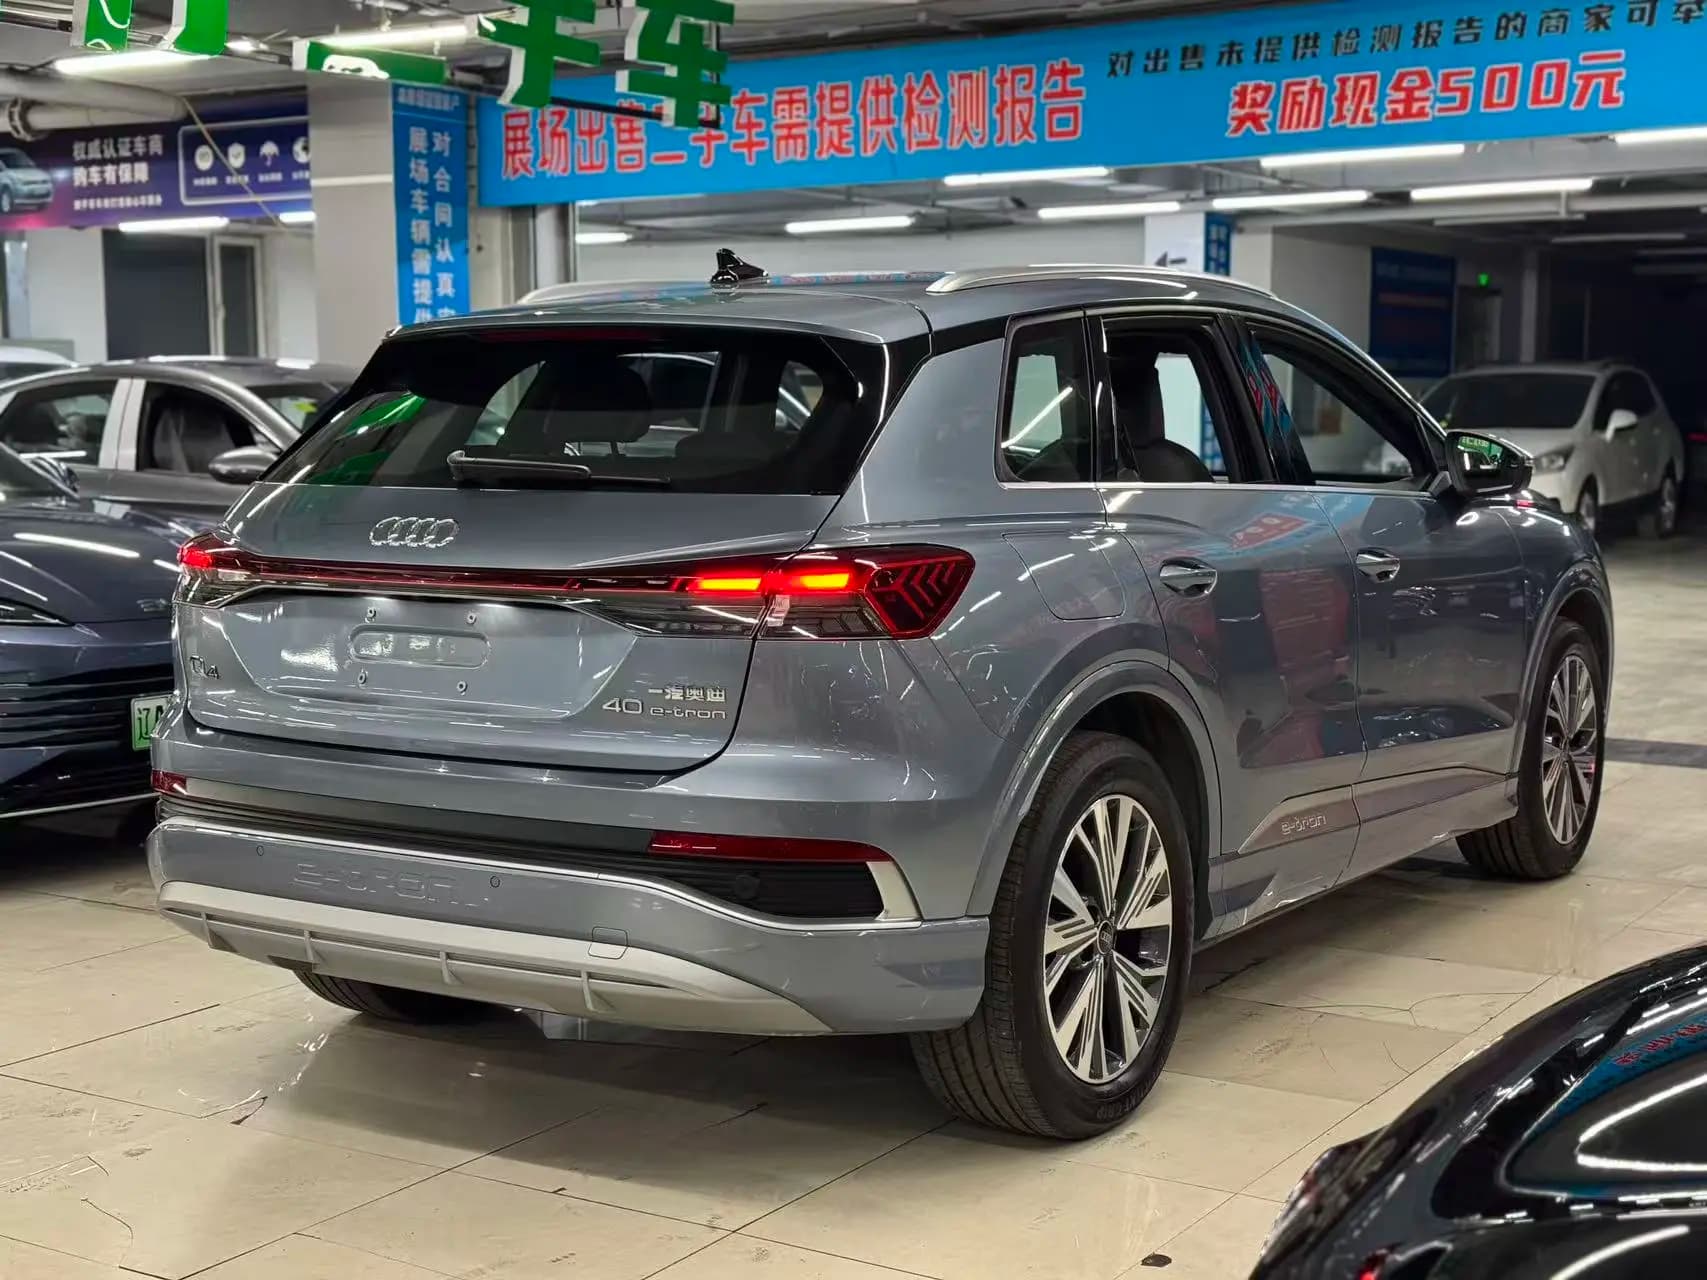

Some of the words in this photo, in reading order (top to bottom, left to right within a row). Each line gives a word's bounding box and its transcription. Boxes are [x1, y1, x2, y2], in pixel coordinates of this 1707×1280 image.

[501, 58, 1086, 179] 展场出售二手车需提供检测报告
[1226, 50, 1626, 138] 奖励现金500元
[602, 698, 643, 714] 40
[650, 706, 727, 720] e-tron
[1281, 815, 1327, 836] e-tron
